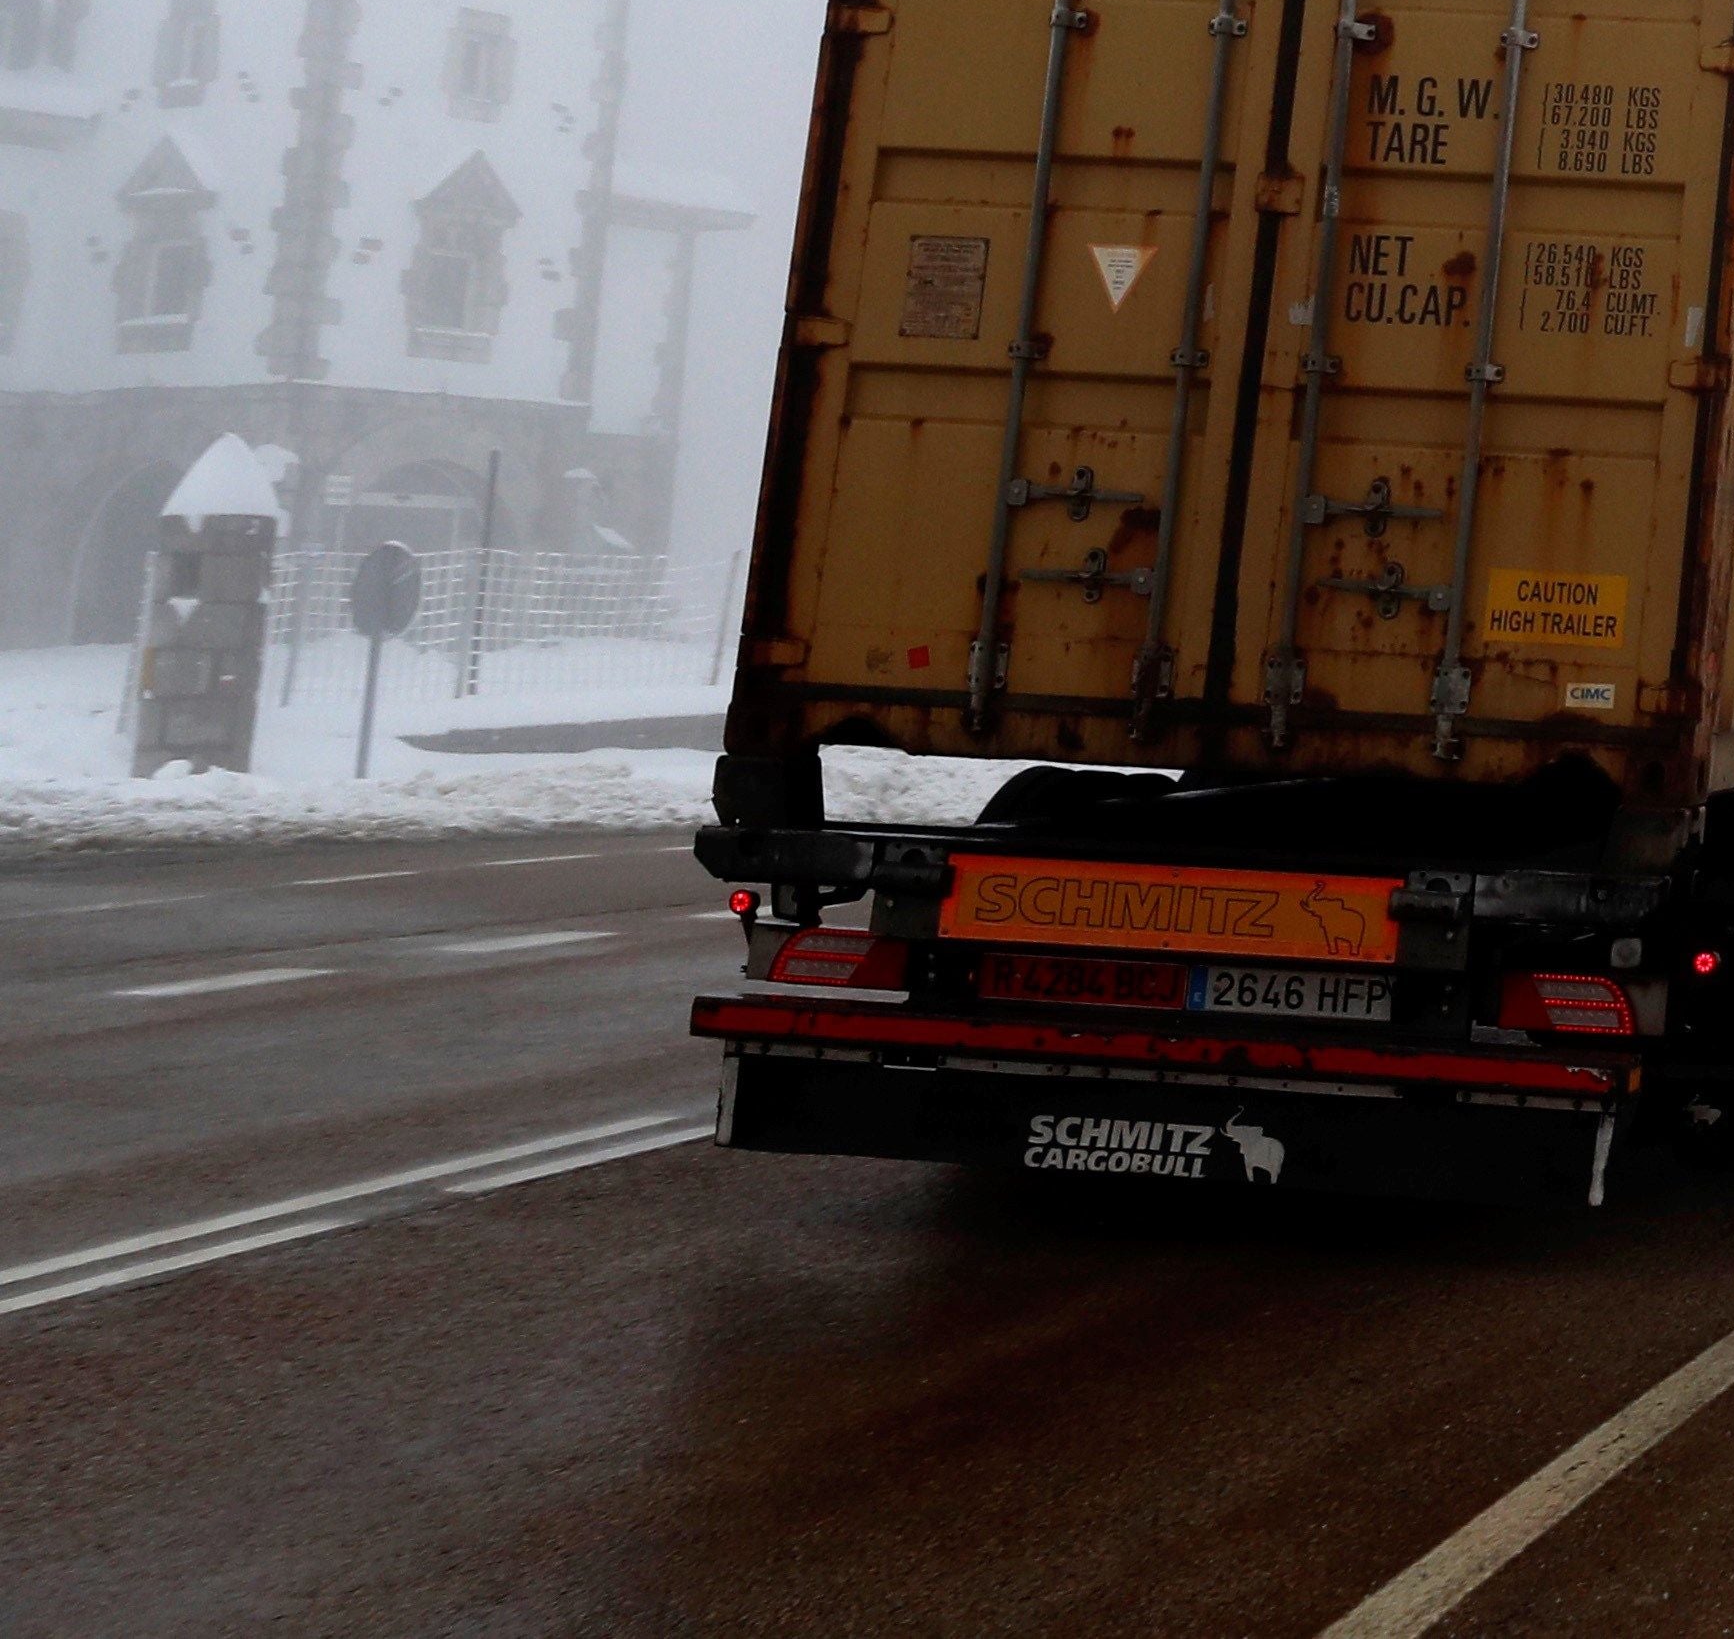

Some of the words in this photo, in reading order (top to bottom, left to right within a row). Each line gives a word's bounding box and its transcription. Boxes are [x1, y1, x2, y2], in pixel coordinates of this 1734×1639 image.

[1553, 82, 1615, 107] 30.480
[1627, 86, 1661, 108] KGS
[1549, 105, 1612, 128] 67.200
[1625, 108, 1660, 129] LBS
[1366, 121, 1450, 165] TARE
[1560, 129, 1610, 151] 3.940
[1623, 131, 1657, 153] KGS
[1557, 151, 1607, 173] 8.690
[1620, 153, 1655, 175] LBS
[1348, 234, 1414, 278] NET
[1535, 243, 1597, 265] 26.540
[1610, 246, 1645, 268] KGS
[1608, 268, 1642, 290] LBS
[1344, 282, 1471, 329] CU.CAP.
[1555, 289, 1592, 312] 76.4
[1604, 291, 1662, 317] CU.MT.
[1539, 312, 1590, 334] 2.700
[1603, 315, 1654, 338] CU.FT.
[1516, 579, 1599, 606] CAUTION
[1489, 609, 1536, 634] HIGH
[1540, 611, 1617, 639] TRAILER
[1569, 686, 1611, 703] CIMC
[975, 874, 1281, 938] SCHMITZ
[1212, 971, 1304, 1010] 2646
[1317, 976, 1388, 1015] HFP
[1028, 1113, 1217, 1155] SCHMITZ
[1024, 1146, 1208, 1179] CARGOBULL
